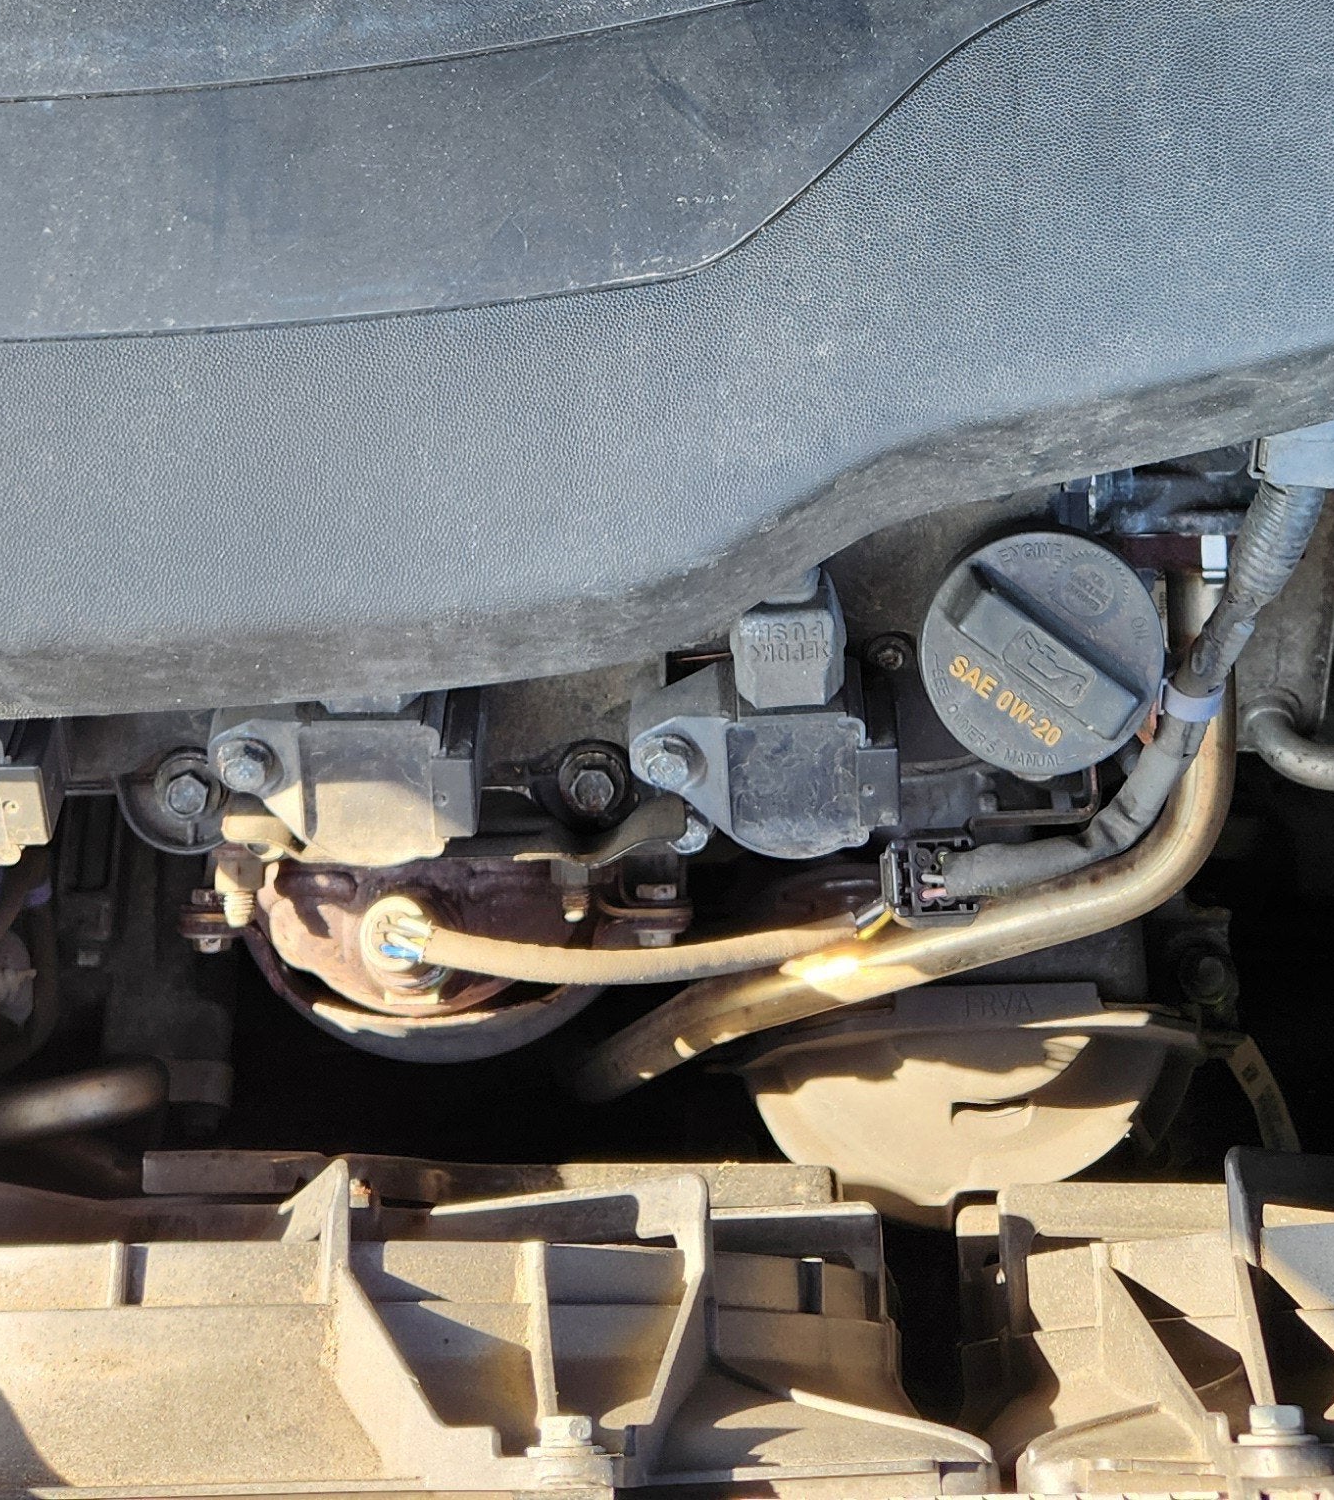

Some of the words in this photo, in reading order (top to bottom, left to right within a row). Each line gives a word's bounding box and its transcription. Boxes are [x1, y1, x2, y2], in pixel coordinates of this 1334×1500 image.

[753, 621, 825, 643] PUSH
[1000, 541, 1065, 564] ENGINE
[1130, 616, 1149, 645] OIL
[930, 668, 950, 698] SEE
[1003, 748, 1066, 768] MANUAL
[948, 654, 999, 700] SAE
[995, 690, 1064, 748] 0W-20
